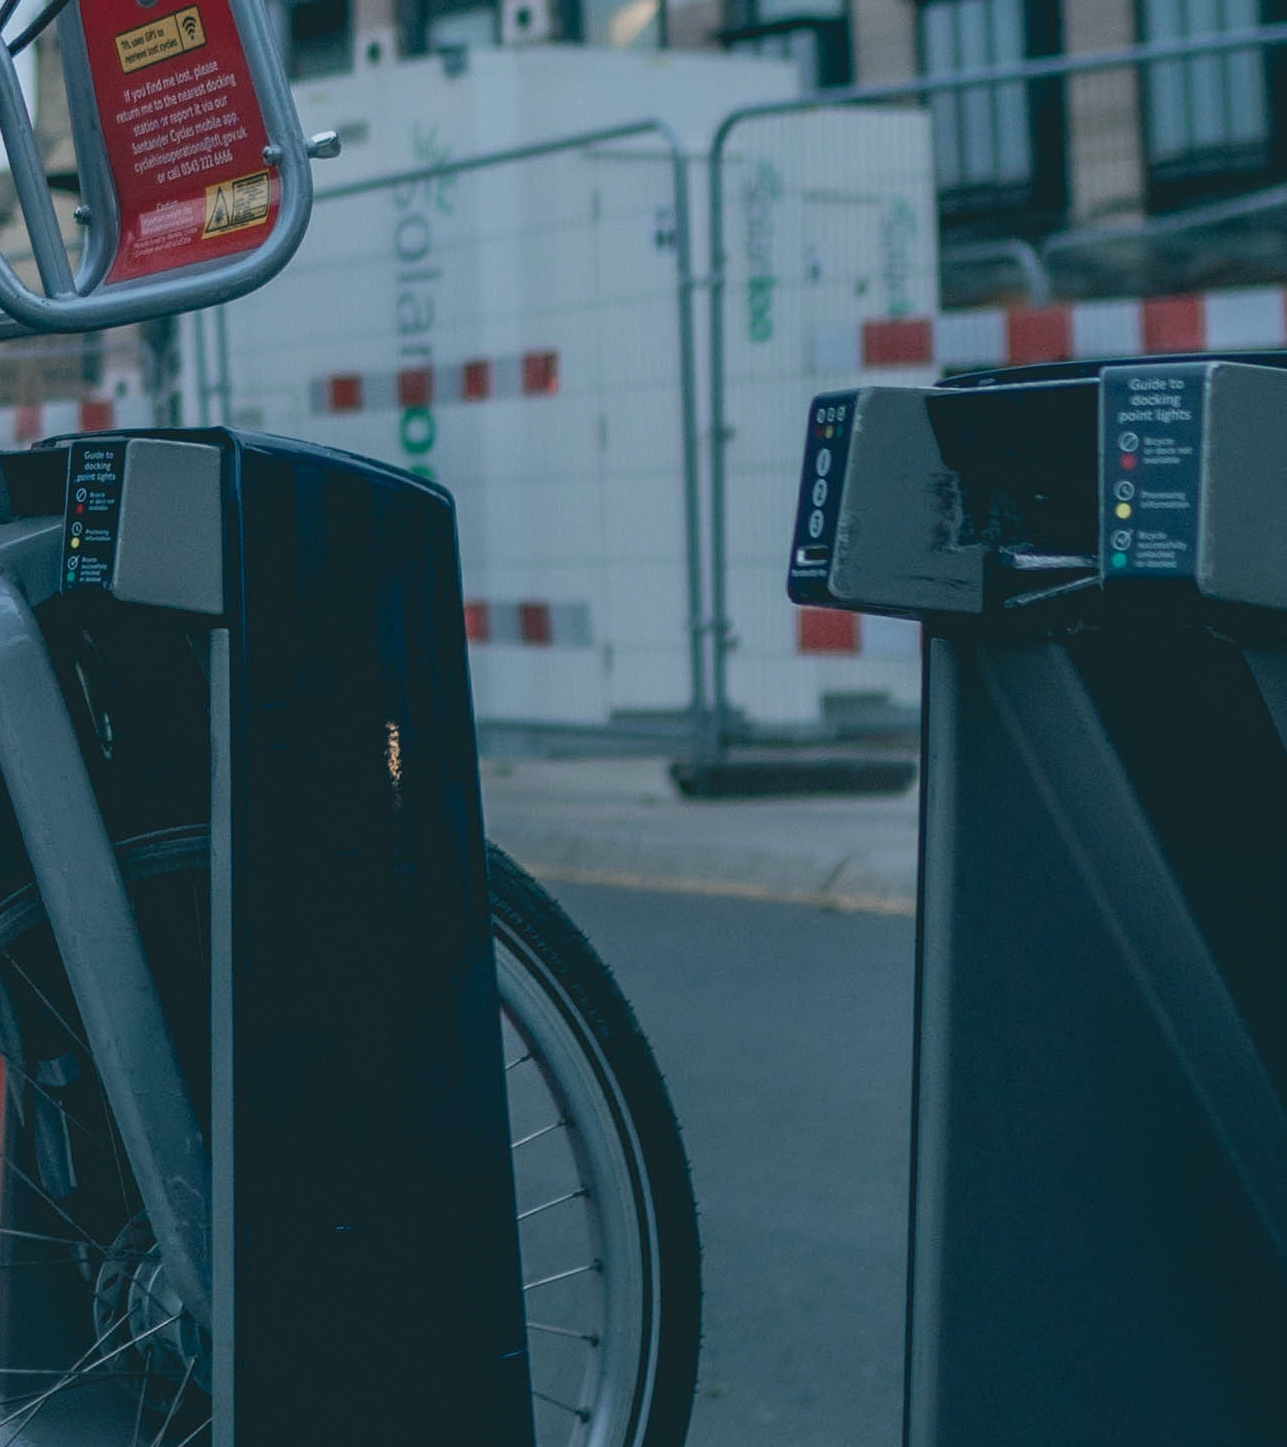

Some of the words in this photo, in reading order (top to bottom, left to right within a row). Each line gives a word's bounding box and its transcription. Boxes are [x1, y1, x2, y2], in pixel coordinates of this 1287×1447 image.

[132, 87, 146, 104] you
[146, 79, 163, 94] find
[163, 77, 176, 88] me
[194, 61, 219, 80] please
[116, 108, 141, 124] return
[141, 103, 154, 115] me
[154, 99, 164, 110] to
[164, 94, 178, 105] the
[178, 85, 206, 103] nearest
[206, 73, 237, 93] docking
[133, 118, 160, 137] station
[170, 106, 194, 125] report
[202, 100, 214, 113] via
[214, 95, 228, 110] our
[131, 134, 169, 155] Santander
[170, 125, 195, 144] Cycles
[195, 115, 222, 134] mobile
[157, 171, 166, 184] or
[167, 165, 182, 181] call
[201, 157, 214, 171] 222
[1128, 378, 1166, 391] Guide
[1170, 378, 1185, 391] to
[1130, 393, 1182, 409] docking
[1118, 410, 1153, 425] point
[1156, 409, 1192, 425] lights
[84, 451, 105, 460] Guide
[84, 462, 112, 473] docking
[76, 473, 95, 483] point
[96, 473, 116, 483] lights
